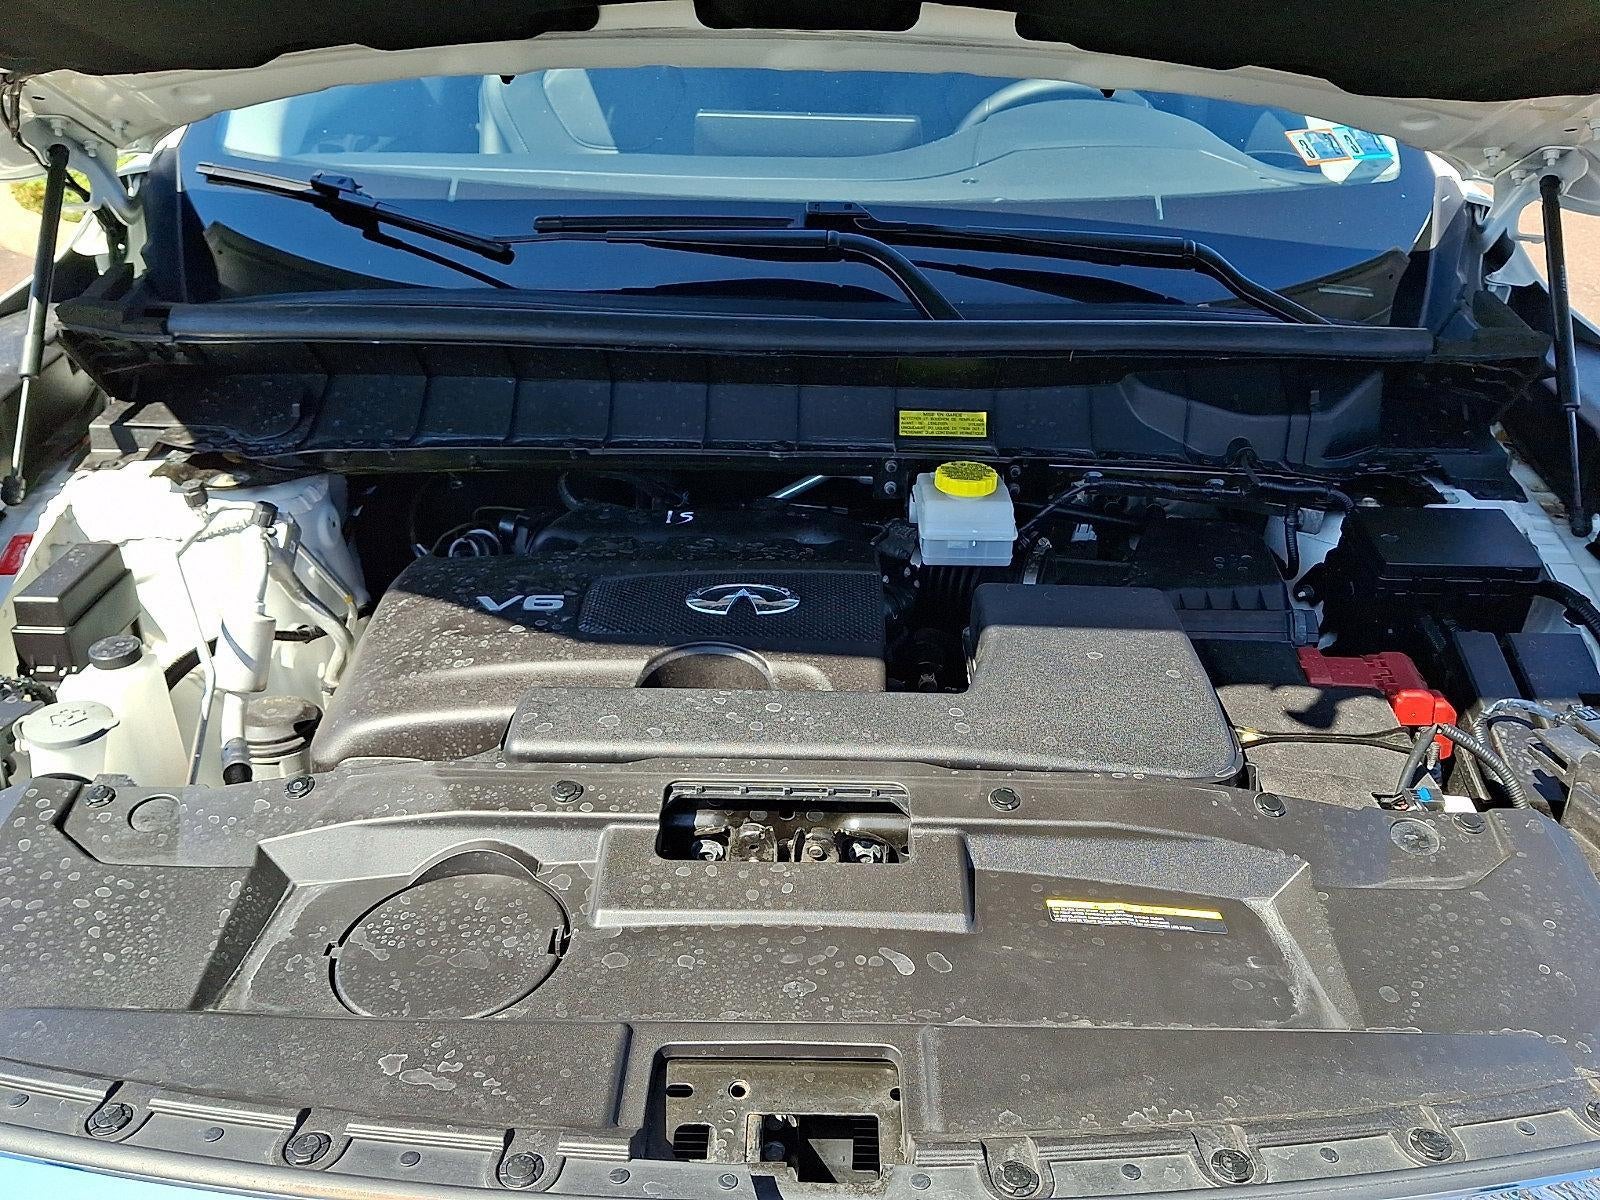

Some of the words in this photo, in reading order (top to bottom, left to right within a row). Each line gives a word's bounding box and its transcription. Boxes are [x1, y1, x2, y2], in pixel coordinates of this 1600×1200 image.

[1299, 139, 1316, 159] 3
[1343, 134, 1360, 154] 3
[476, 594, 564, 611] V6
